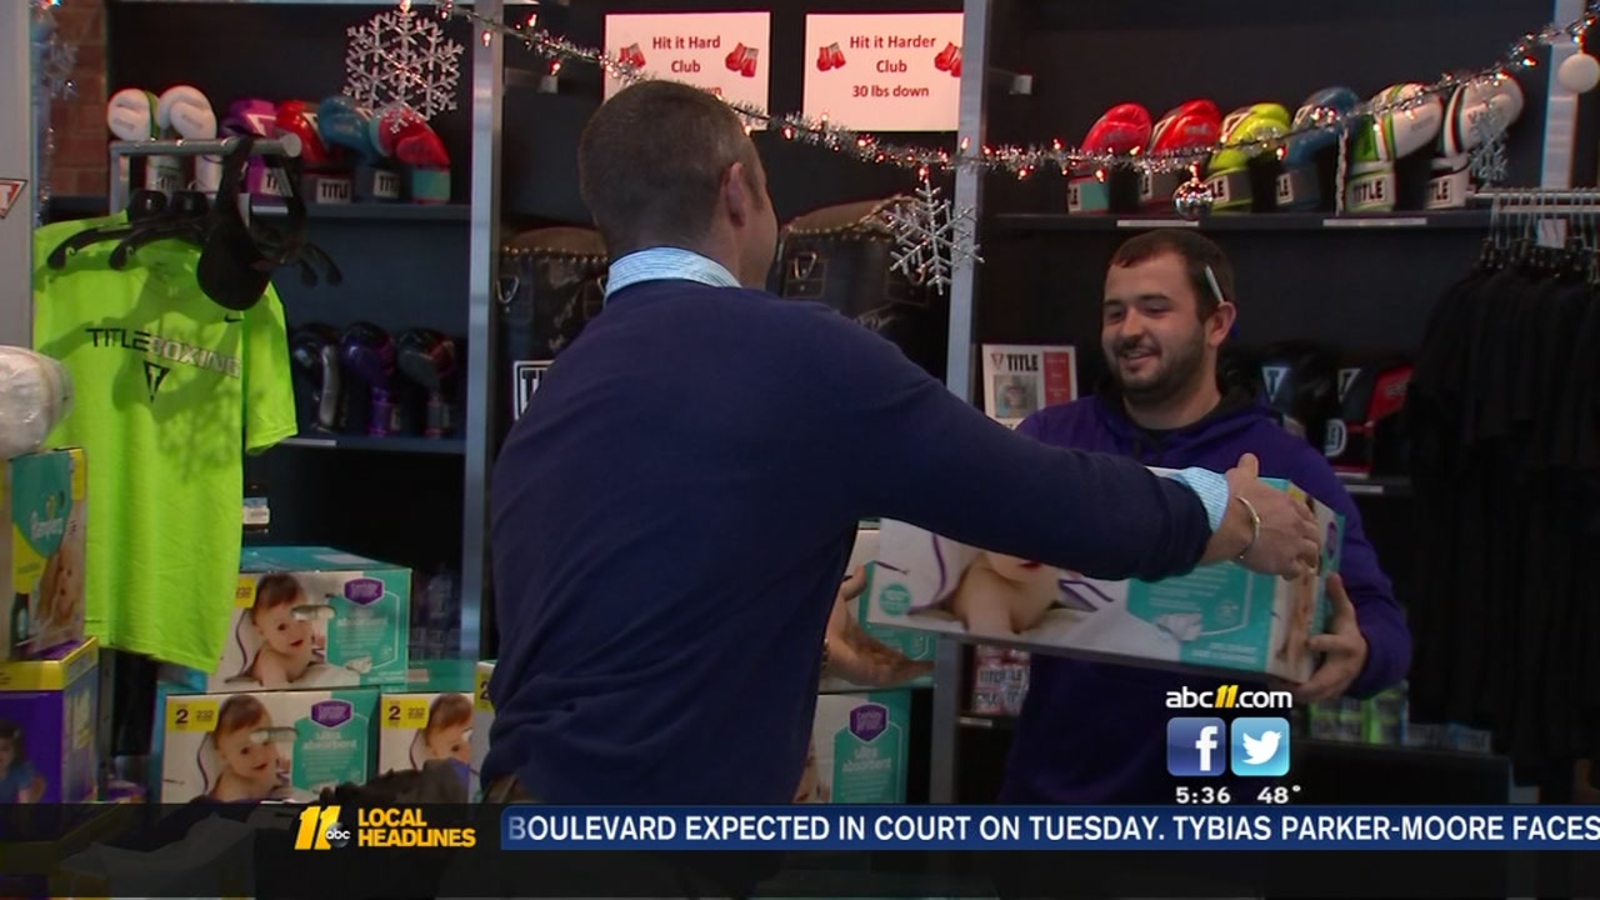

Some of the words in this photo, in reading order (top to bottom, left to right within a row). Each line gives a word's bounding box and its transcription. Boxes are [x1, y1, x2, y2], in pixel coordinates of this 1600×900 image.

[653, 36, 671, 49] Hit
[675, 36, 685, 49] it
[688, 35, 721, 49] Hard
[850, 35, 870, 49] Hit
[874, 36, 884, 49] it
[888, 35, 936, 49] Harder
[671, 59, 700, 74] Club
[876, 59, 907, 74] Club
[853, 85, 868, 98] 30
[871, 84, 889, 98] lbs
[892, 85, 929, 98] down
[1353, 180, 1382, 202] TITLE
[1007, 353, 1039, 371] TITLE
[176, 708, 189, 724] 2
[389, 705, 401, 720] 2
